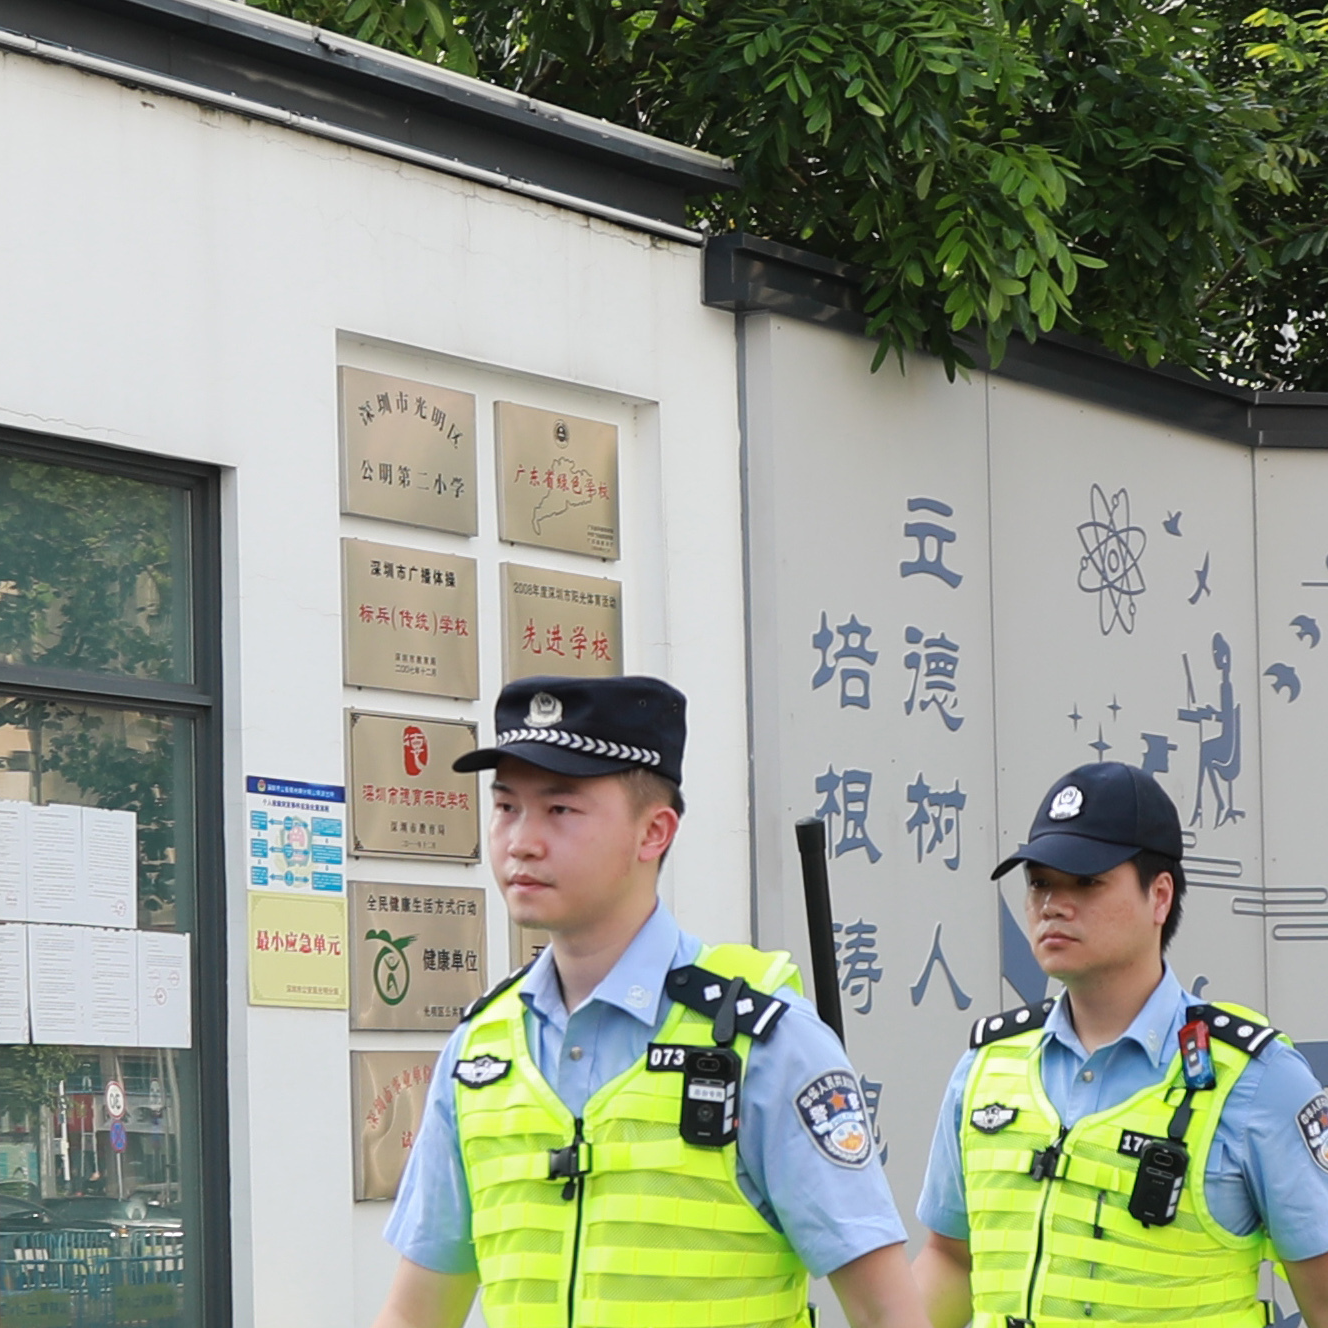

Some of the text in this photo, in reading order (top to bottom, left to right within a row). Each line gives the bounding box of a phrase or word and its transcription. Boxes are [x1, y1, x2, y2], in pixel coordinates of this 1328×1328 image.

[357, 391, 464, 449] 深圳市光明区
[360, 459, 465, 498] 公明第二小学
[514, 463, 610, 500] 广东省绿色学校
[370, 560, 456, 588] 深圳市广播体操
[522, 618, 613, 661] 先进学校
[899, 497, 973, 1011] 立德树人
[367, 895, 477, 916] 全民健康生活方式行动
[256, 930, 341, 956] 最小应急单元
[423, 948, 478, 972] 健康单位
[650, 1047, 685, 1066] 073
